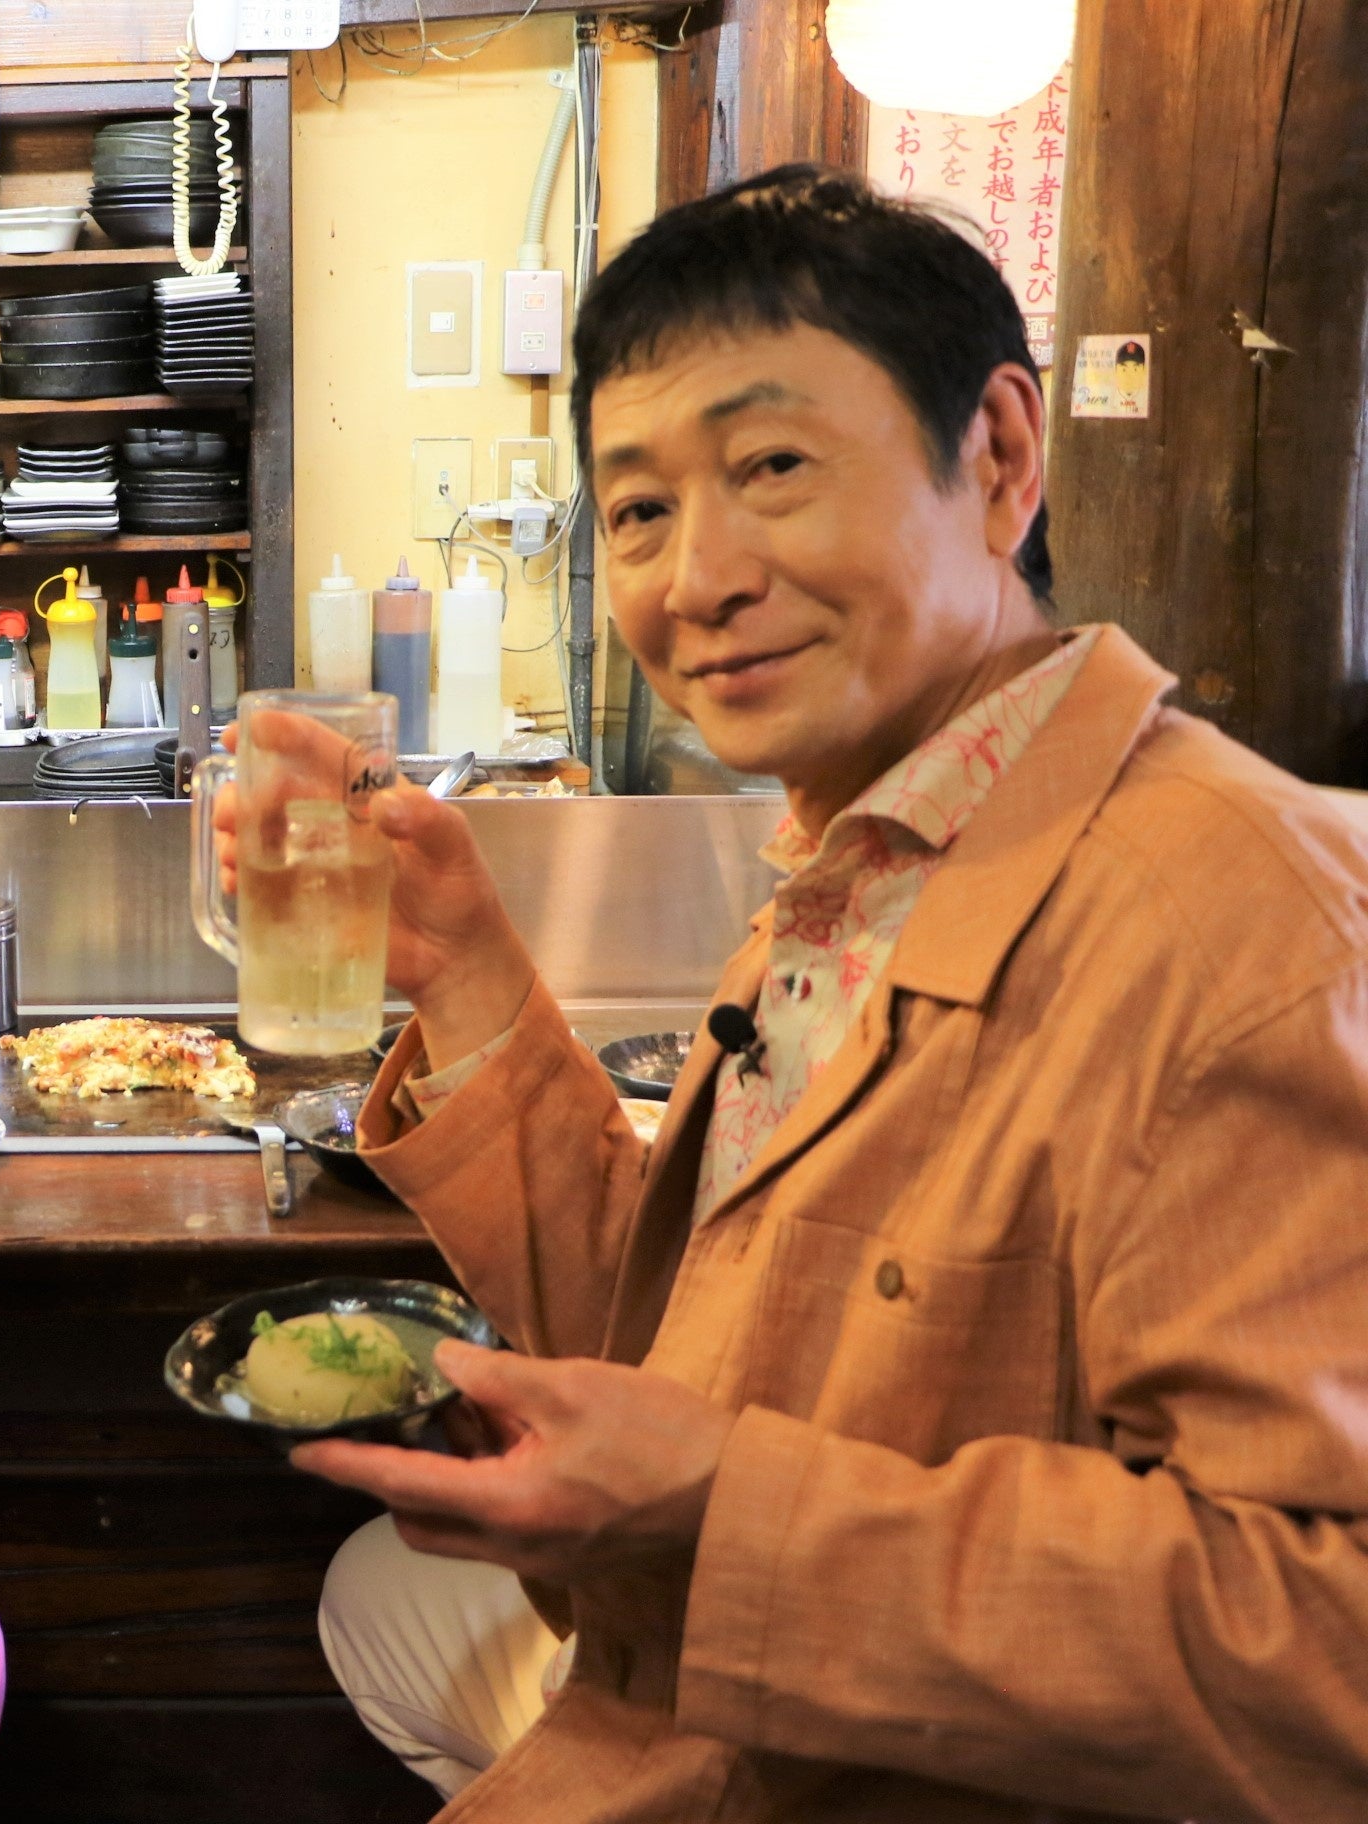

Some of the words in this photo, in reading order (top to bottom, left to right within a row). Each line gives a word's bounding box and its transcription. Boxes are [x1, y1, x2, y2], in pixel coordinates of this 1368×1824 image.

[284, 9, 292, 19] 8
[304, 9, 312, 19] 9
[284, 27, 292, 37] 0
[895, 110, 921, 206] おり
[939, 113, 972, 187] 文を
[982, 107, 1019, 273] でお越しの
